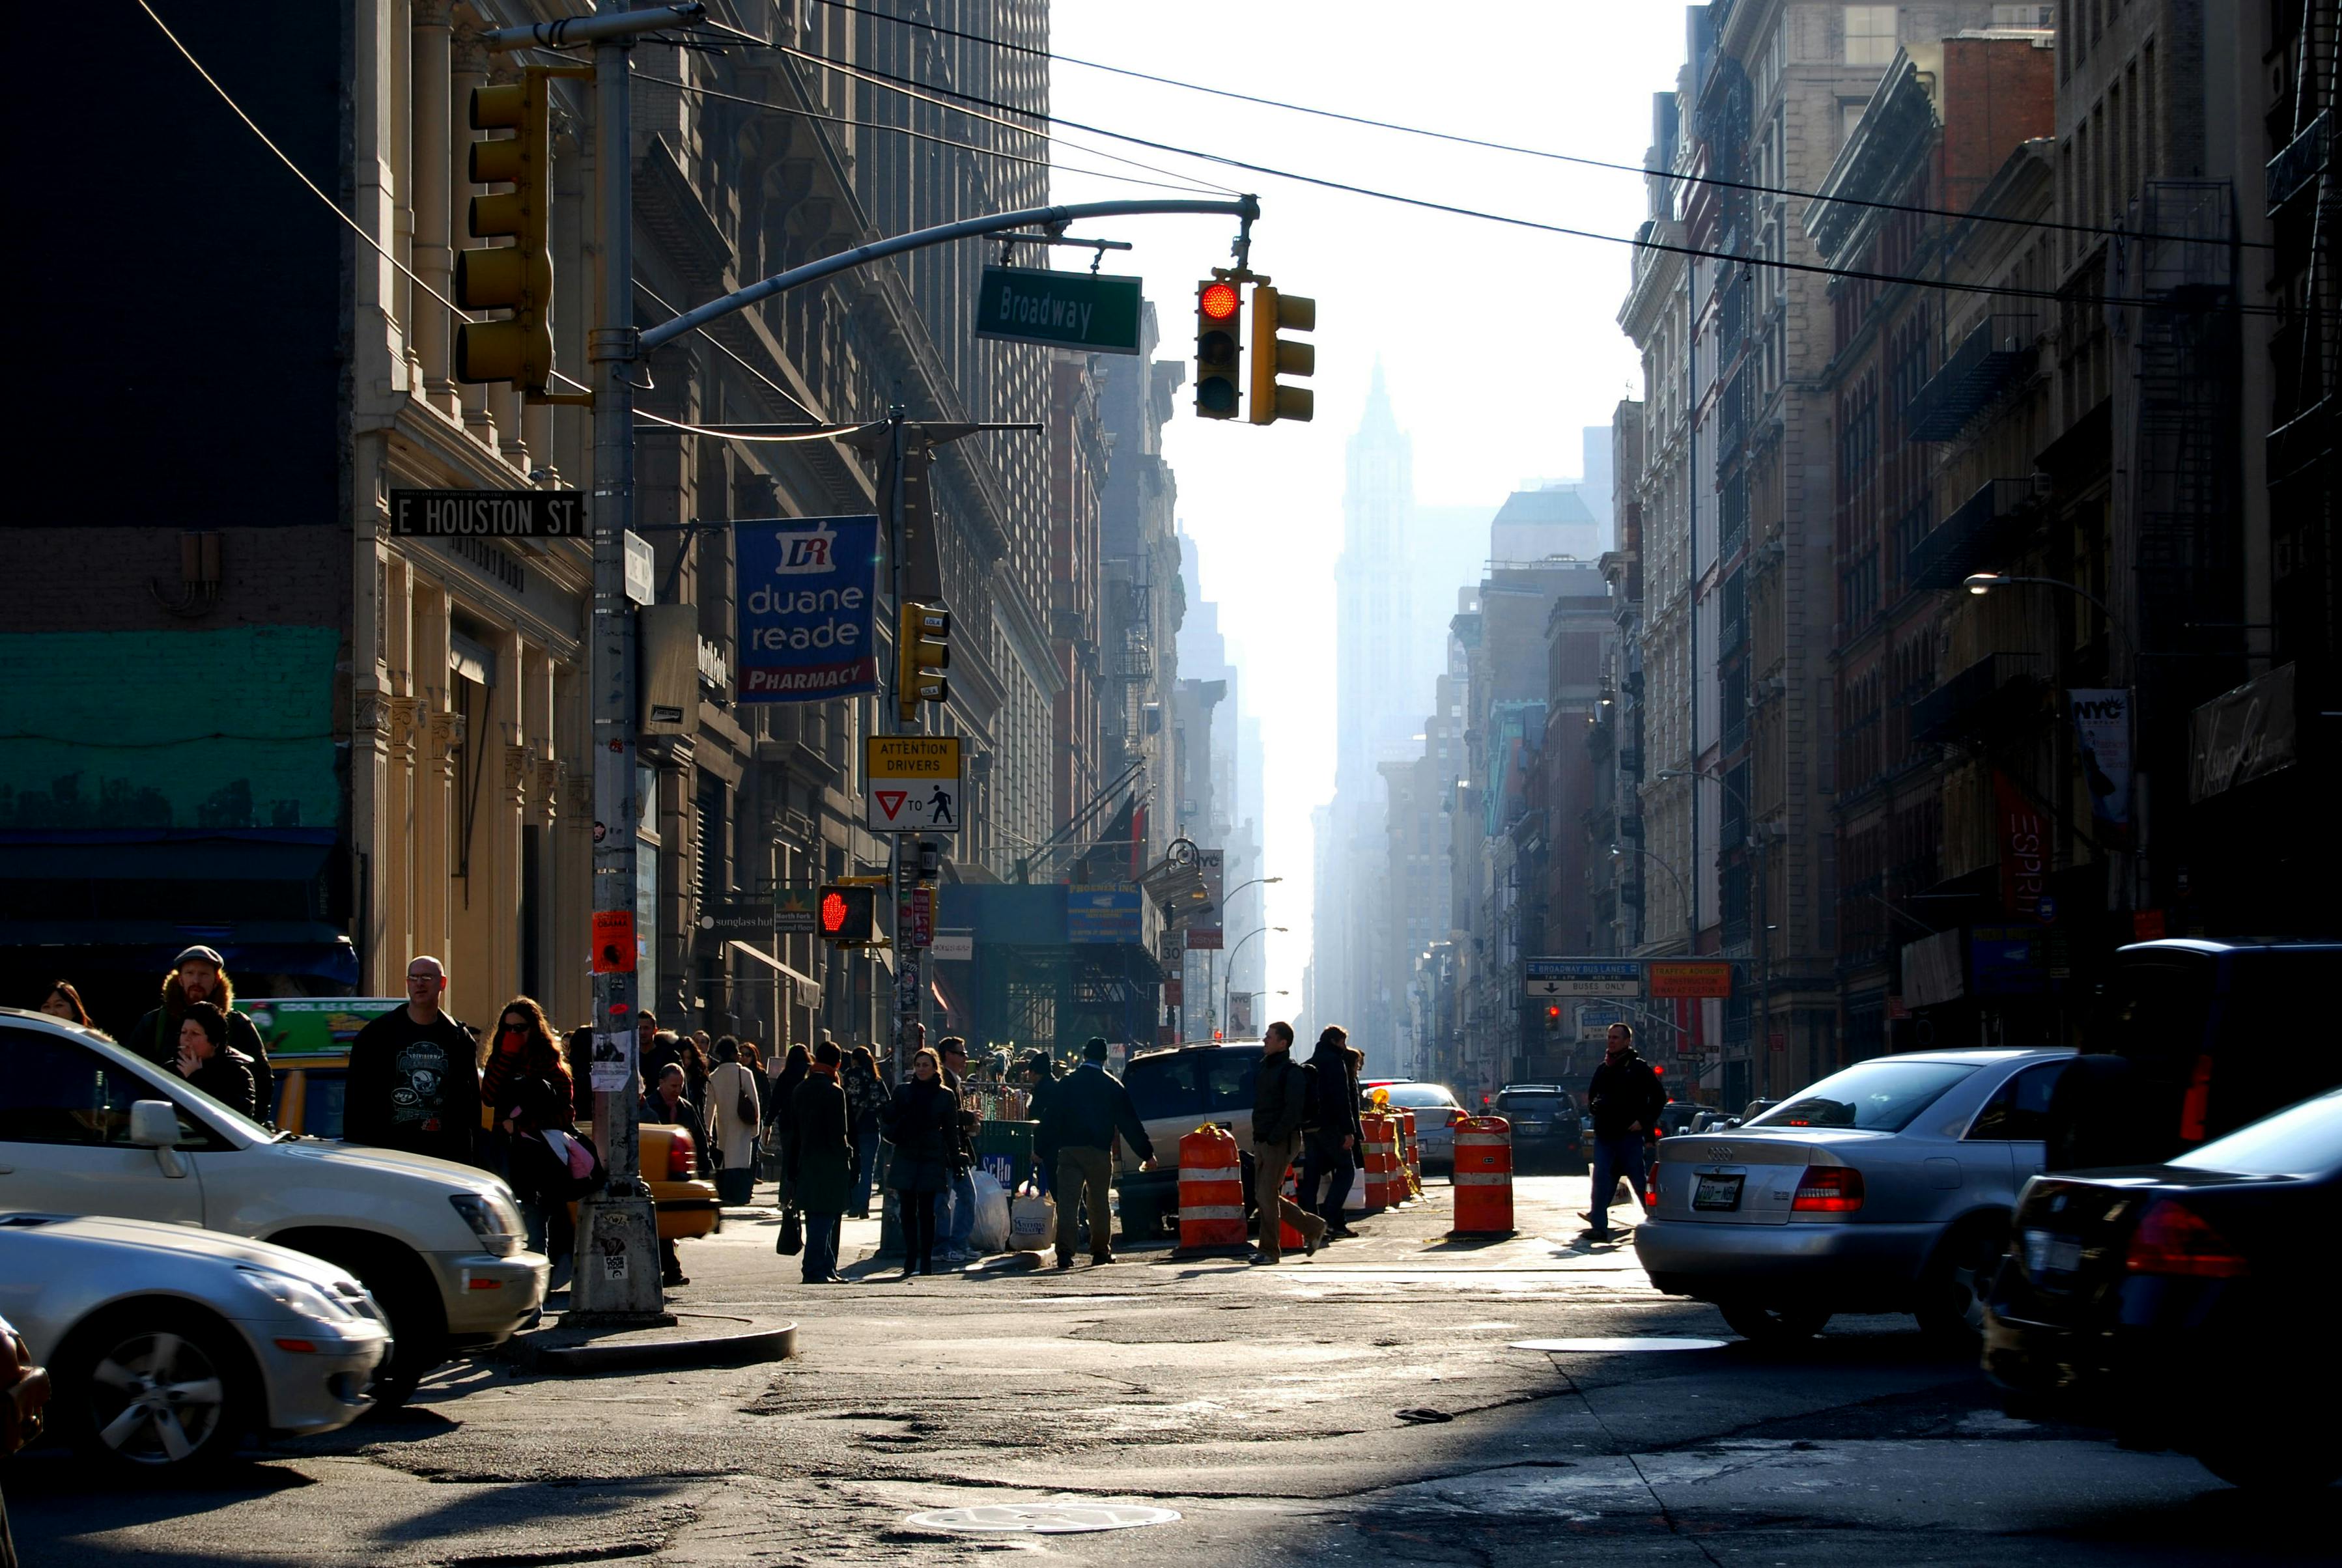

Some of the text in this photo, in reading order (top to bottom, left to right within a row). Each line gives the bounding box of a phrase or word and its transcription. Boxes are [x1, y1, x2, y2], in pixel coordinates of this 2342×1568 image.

[1000, 286, 1092, 339] Broadway
[399, 499, 574, 534] E HOUSTON ST
[748, 584, 864, 614] duane
[752, 617, 860, 651] reade
[749, 665, 860, 690] PHARMACY
[2074, 695, 2126, 720] NYC
[881, 743, 948, 755] ATTENTION
[887, 759, 940, 772] DRIVERS
[907, 800, 922, 811] TO
[716, 917, 772, 928] sunglass hut
[1164, 947, 1180, 959] 30
[1539, 965, 1581, 973] BROADWAY
